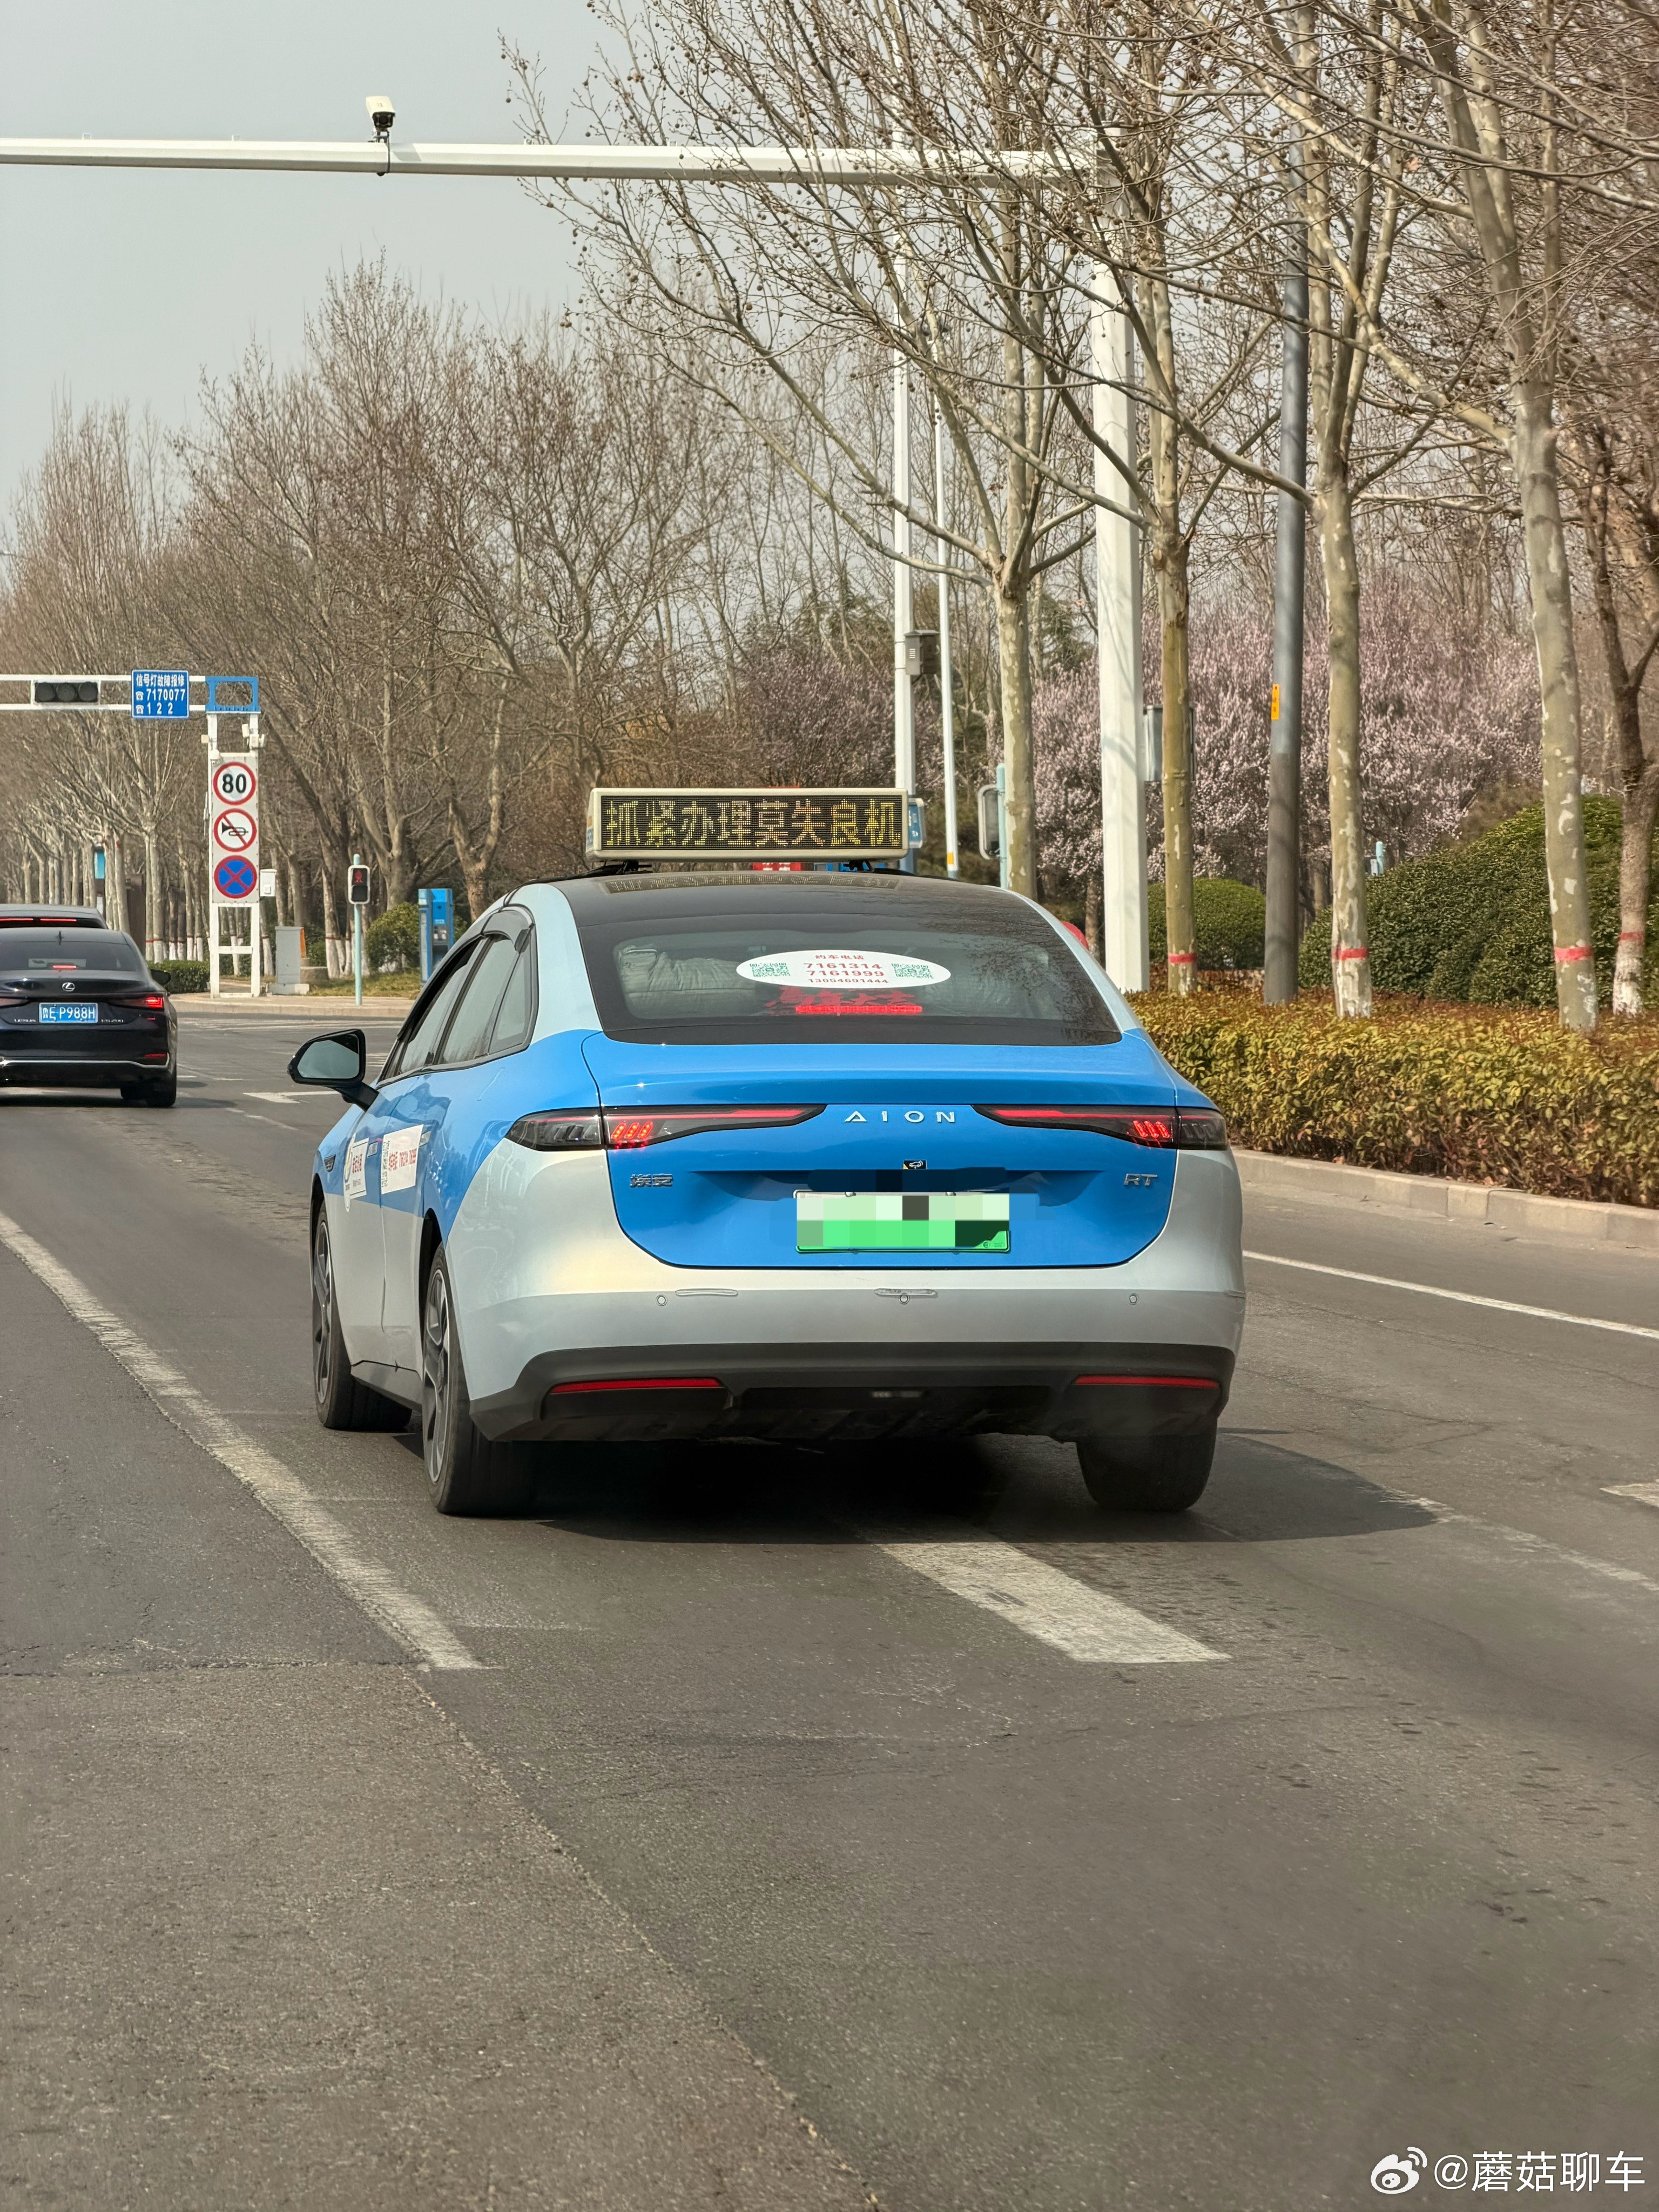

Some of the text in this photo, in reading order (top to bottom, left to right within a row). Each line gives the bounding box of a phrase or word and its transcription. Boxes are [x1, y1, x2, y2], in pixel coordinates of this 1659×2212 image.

[136, 673, 184, 687] 信号灯故障报修
[146, 689, 185, 701] 7170077
[222, 773, 247, 793] 80
[606, 799, 900, 847] 抓紧办理莫失良机
[843, 1110, 955, 1123] AION
[630, 1174, 673, 1188] 埃安
[1123, 1173, 1158, 1186] RT
